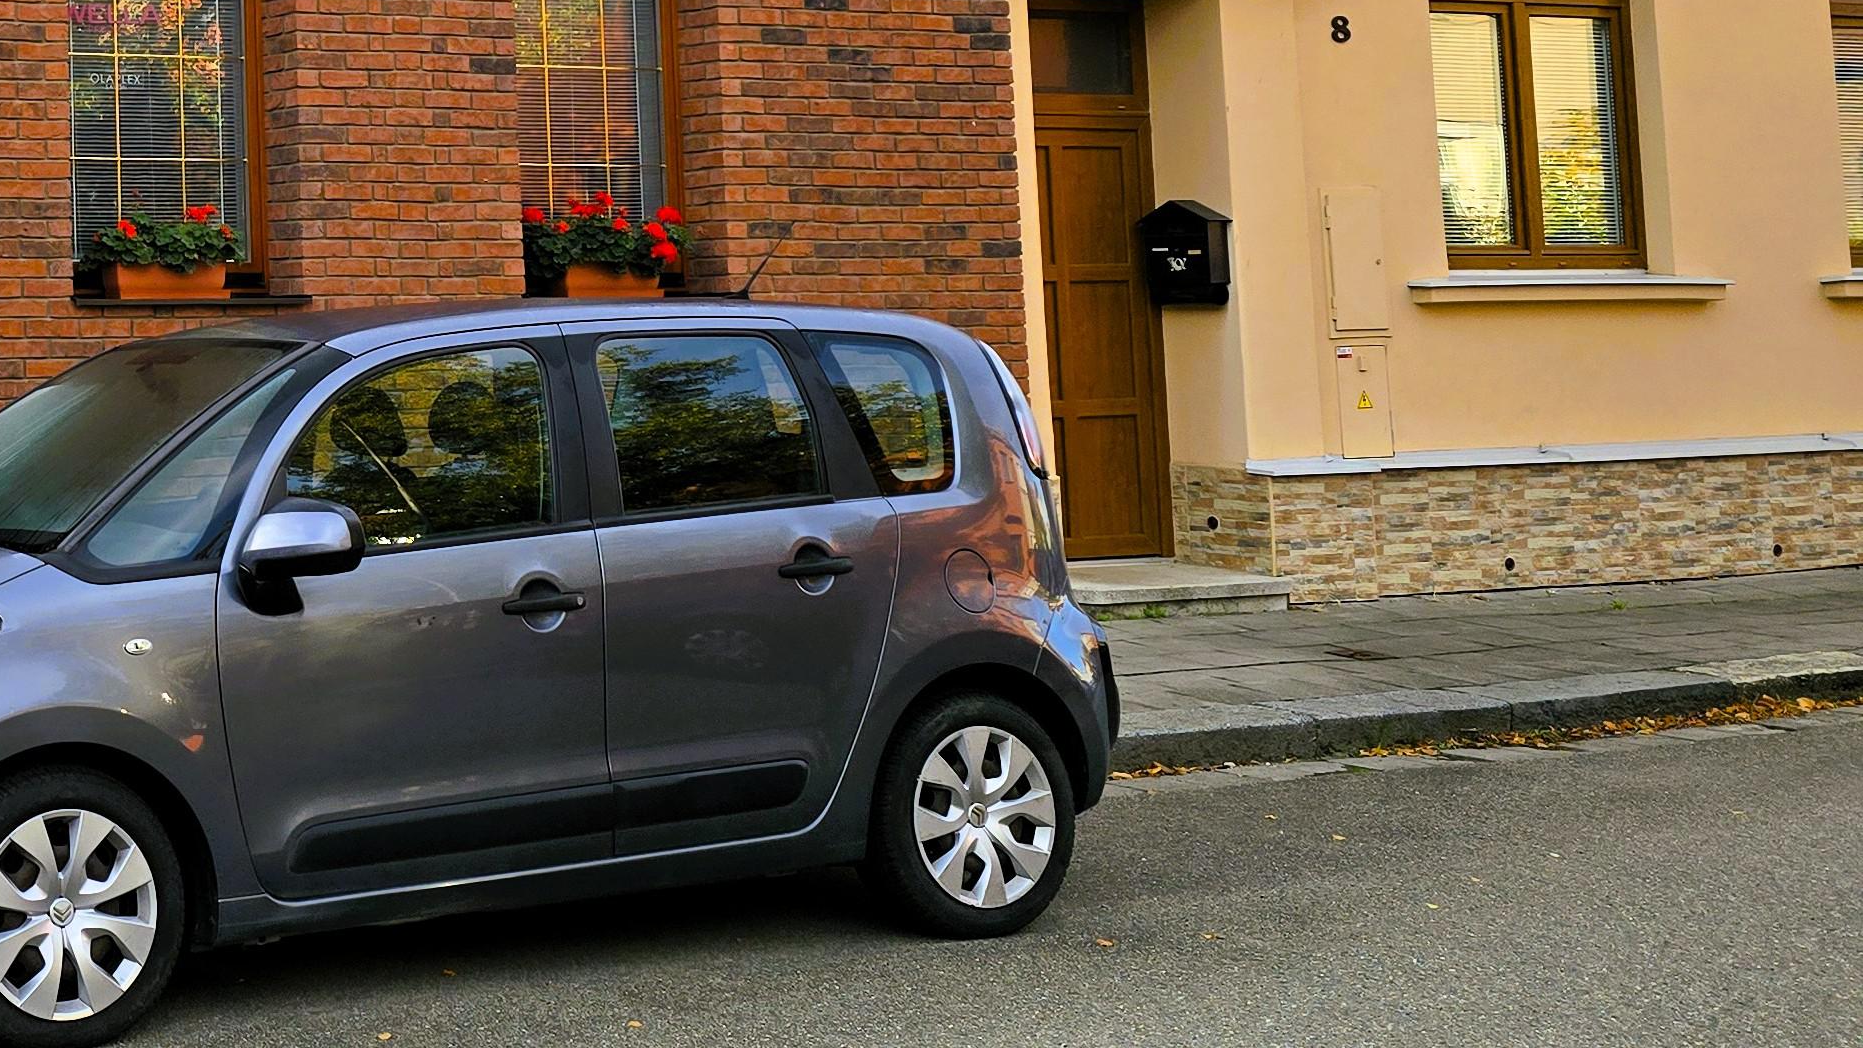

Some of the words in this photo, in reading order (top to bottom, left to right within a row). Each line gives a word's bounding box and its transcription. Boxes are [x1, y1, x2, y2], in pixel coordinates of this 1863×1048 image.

[68, 3, 160, 23] WELLA
[1331, 15, 1351, 43] 8
[90, 73, 141, 84] OLAPLEX
